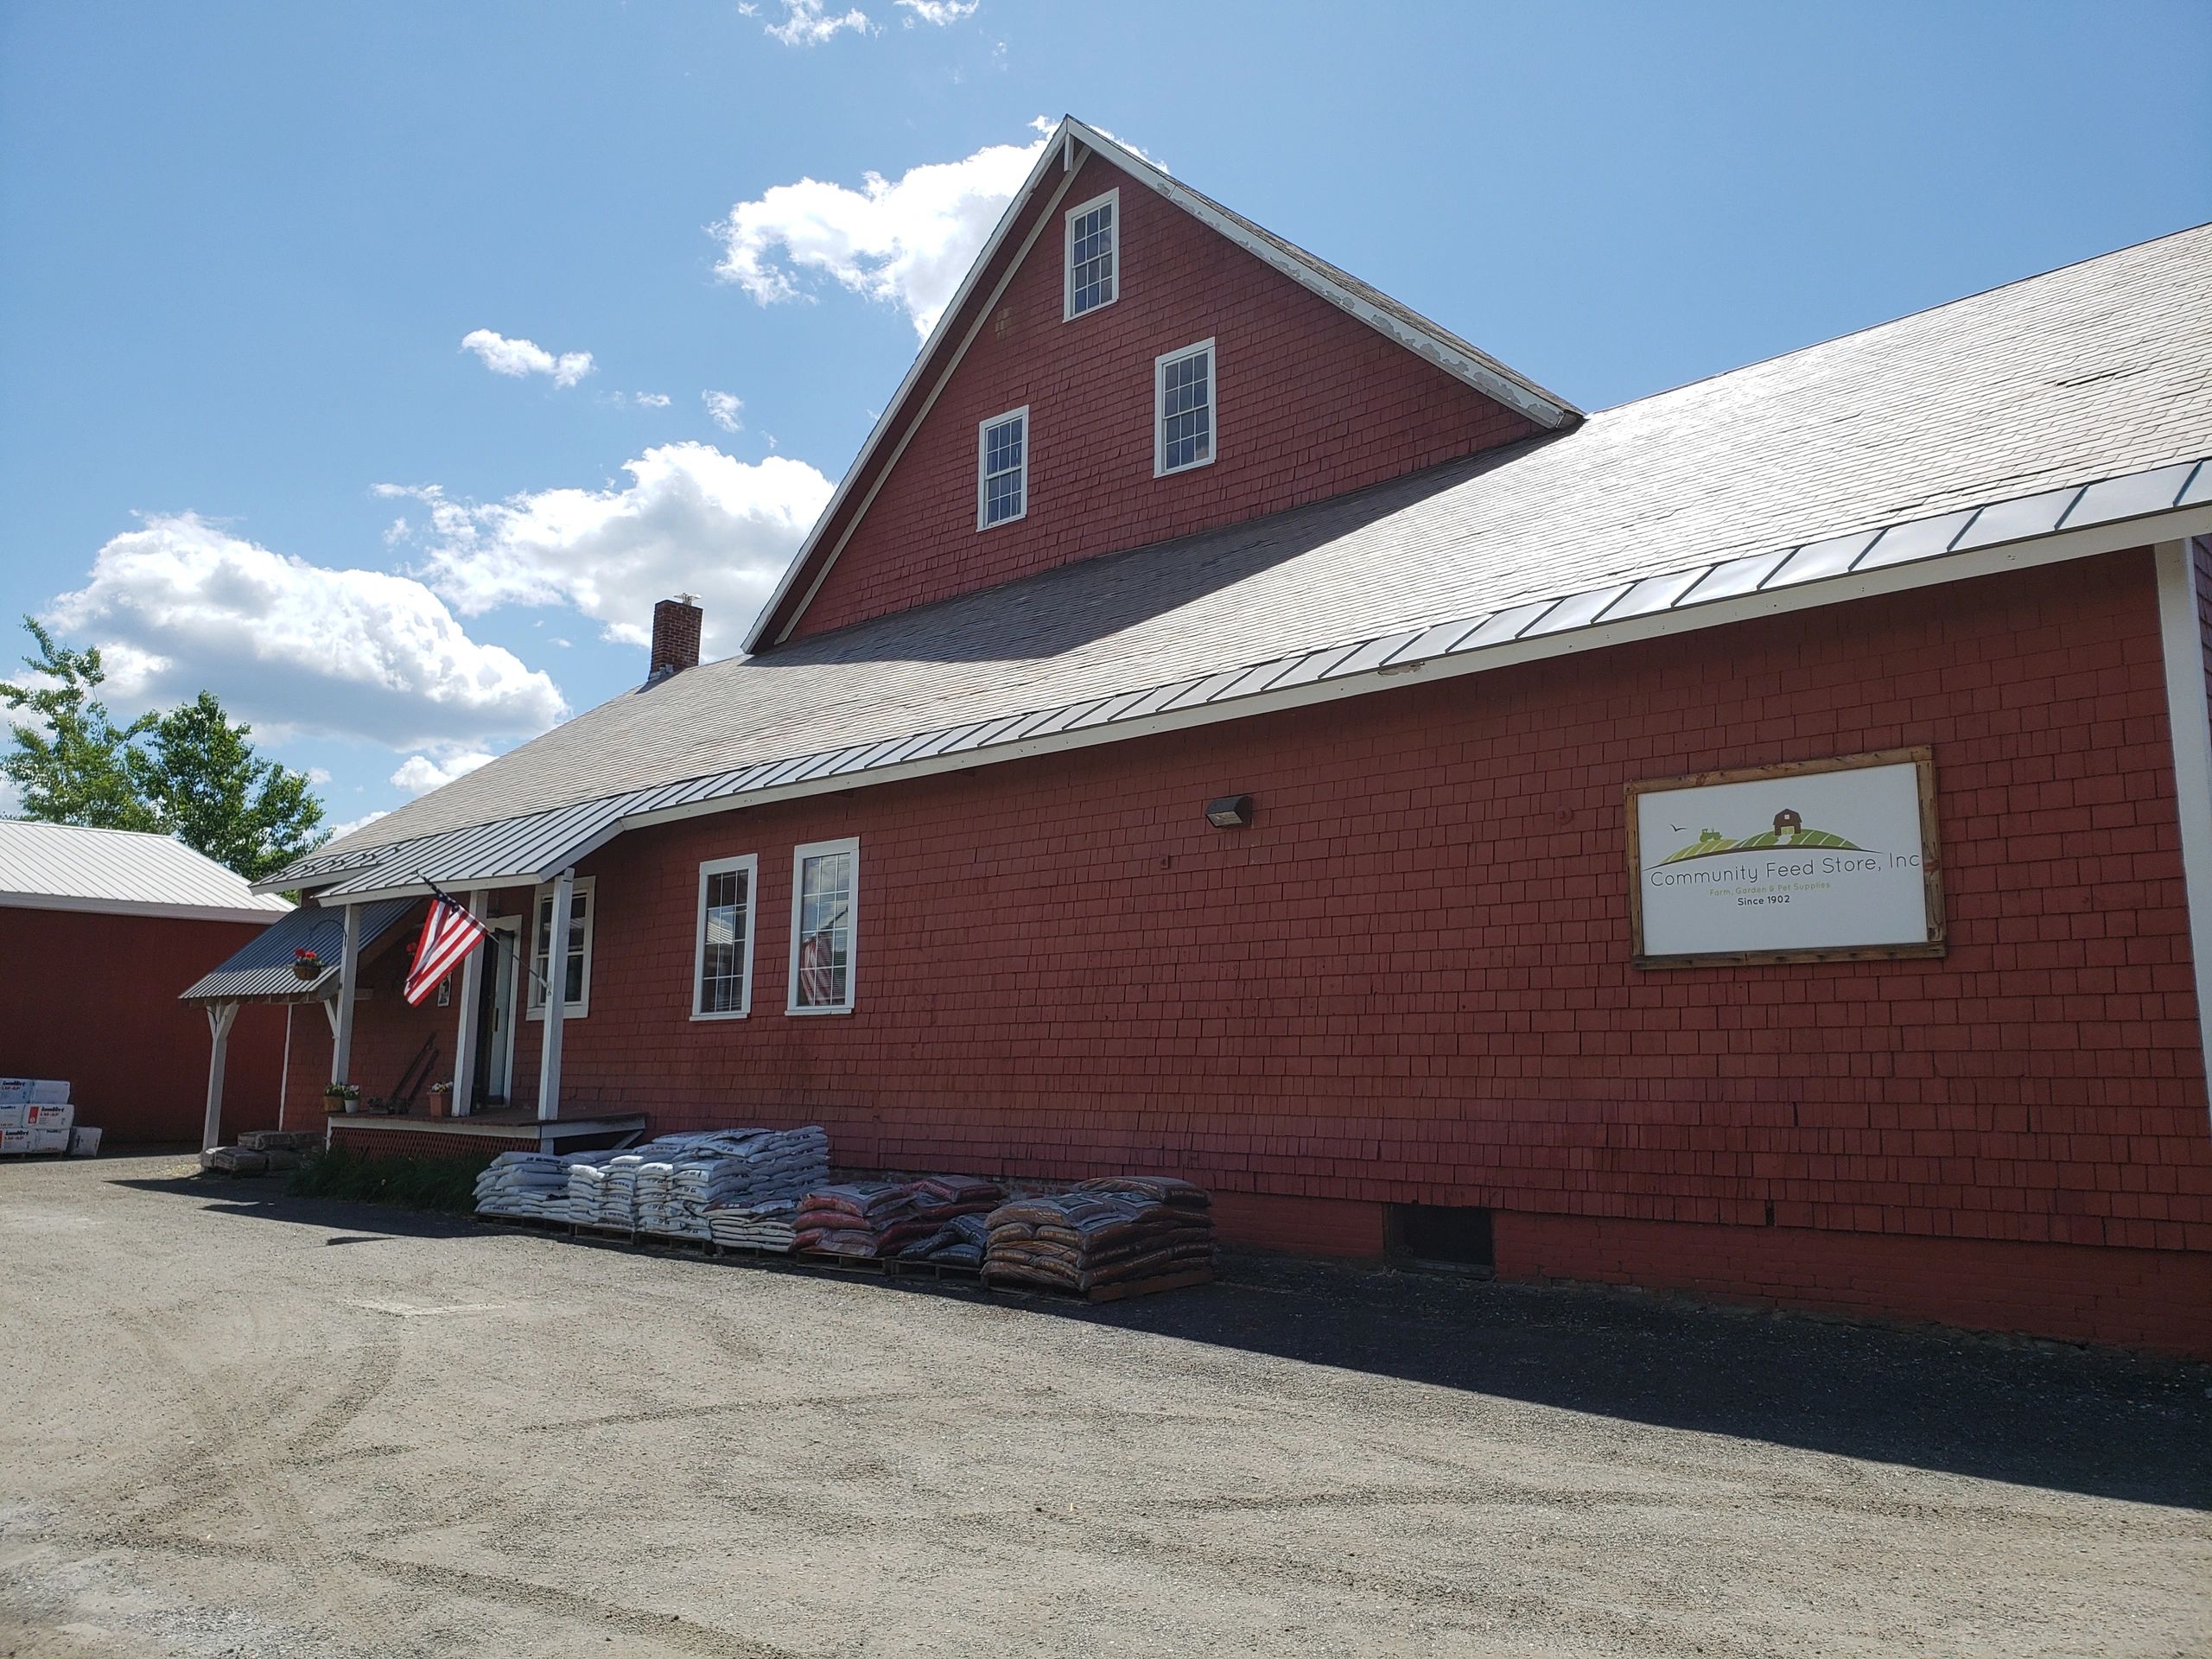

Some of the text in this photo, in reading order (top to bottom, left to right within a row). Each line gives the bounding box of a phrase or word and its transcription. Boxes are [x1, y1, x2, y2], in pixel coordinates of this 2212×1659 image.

[1650, 864, 1758, 887] Community
[1766, 859, 1814, 878] Feed
[1822, 857, 1881, 874] Store,
[1735, 886, 1767, 895] Garden
[1793, 881, 1831, 891] Supplies
[1737, 894, 1790, 906] Since 1902
